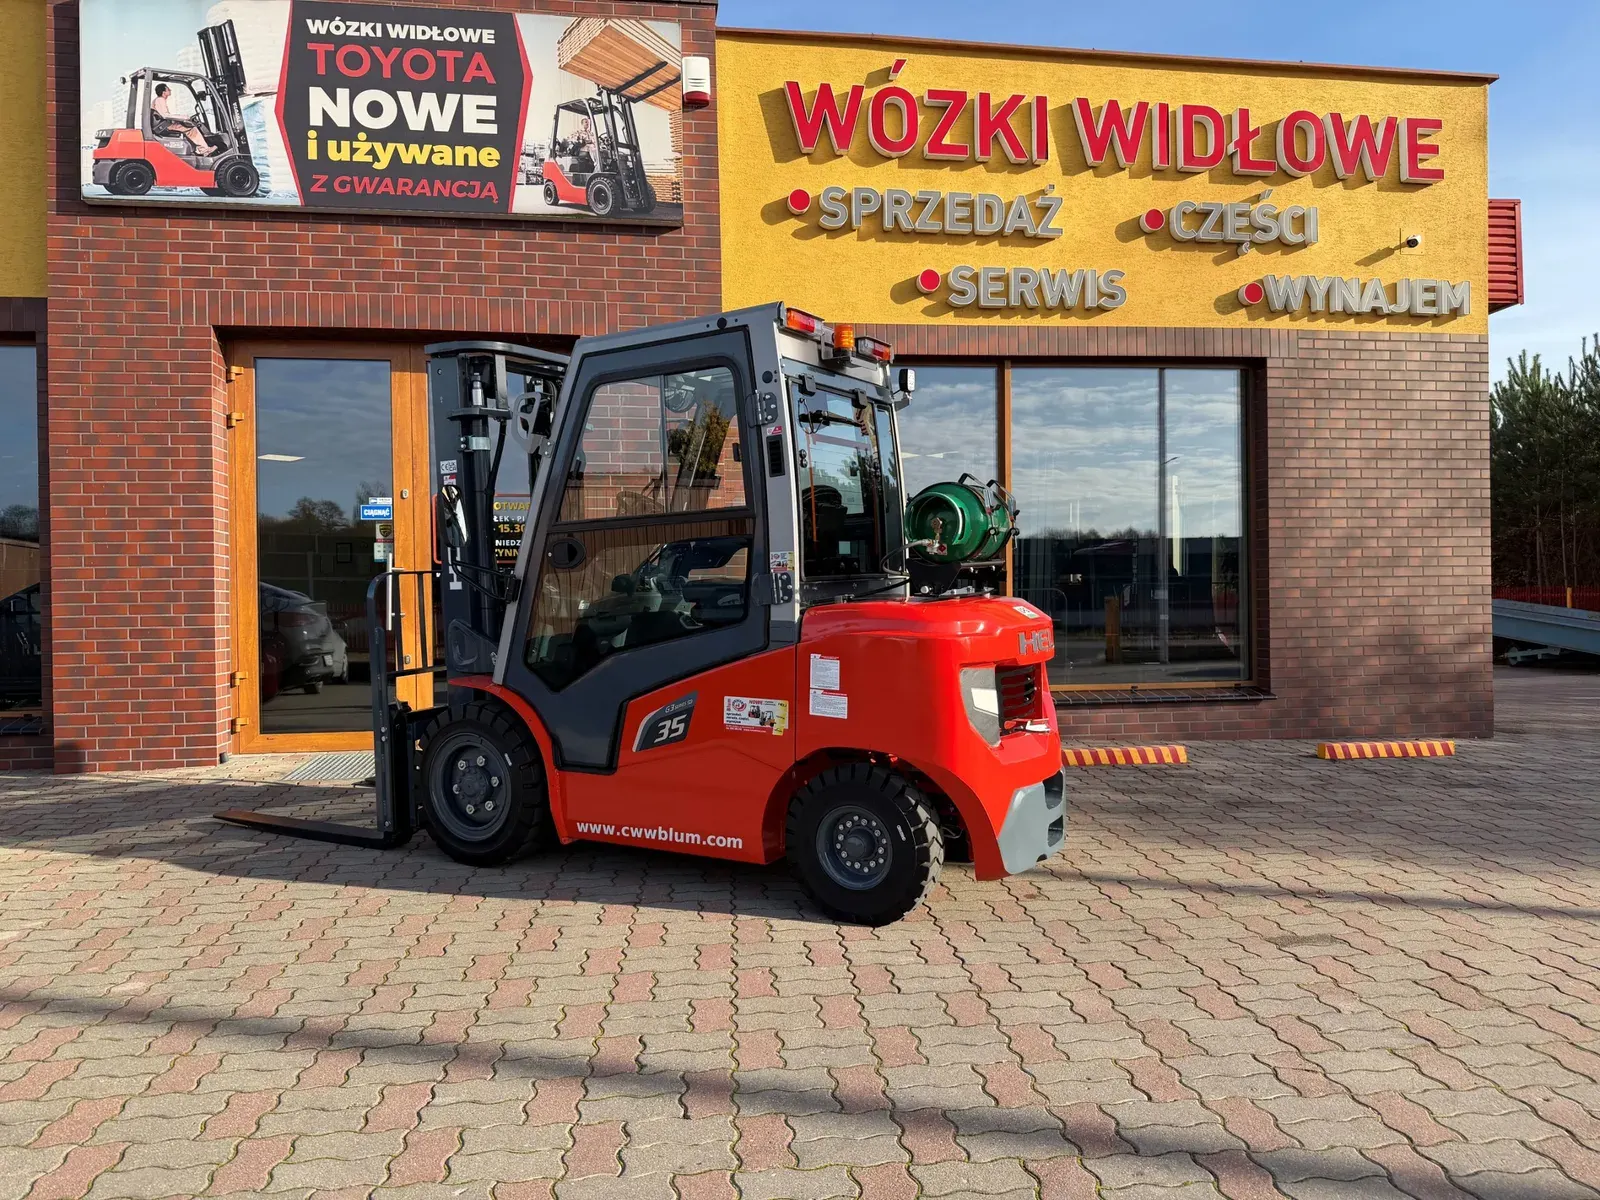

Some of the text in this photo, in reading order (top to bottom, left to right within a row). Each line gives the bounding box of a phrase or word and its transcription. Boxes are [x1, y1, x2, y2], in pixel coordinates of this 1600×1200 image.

[306, 16, 495, 44] WÓZKI WIDŁOWE
[307, 42, 496, 84] TOYOTA
[309, 86, 498, 134] NOWE
[784, 59, 1445, 184] WÓZKI WIDŁOWE
[307, 130, 500, 170] i używane
[310, 174, 499, 204] Z GWARANCJĄ
[818, 184, 1063, 238] SPRZEDAŻ
[1169, 189, 1319, 256] CZĘŚCI
[946, 265, 1127, 310] SERWIS
[1263, 273, 1471, 316] WYNAJEM
[363, 508, 391, 517] CIĄGNĄĆ
[653, 714, 688, 744] 35
[576, 822, 743, 849] www.cwwblum.com
